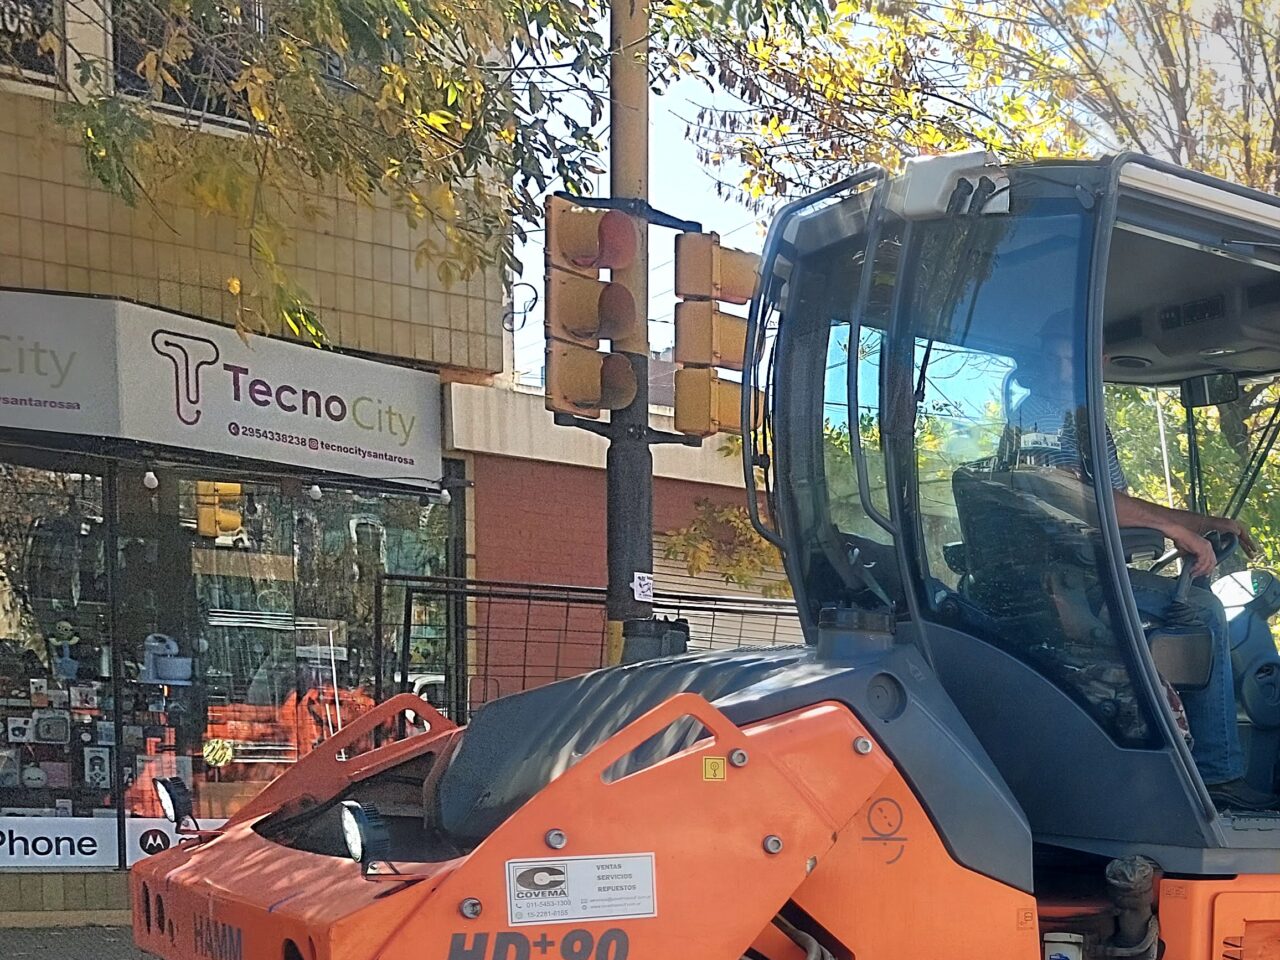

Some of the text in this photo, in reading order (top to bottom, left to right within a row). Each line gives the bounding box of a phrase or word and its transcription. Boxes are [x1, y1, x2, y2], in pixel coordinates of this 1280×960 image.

[241, 425, 415, 466] 2954338238 tecnocitysantarosa
[516, 888, 567, 899] COVEMA
